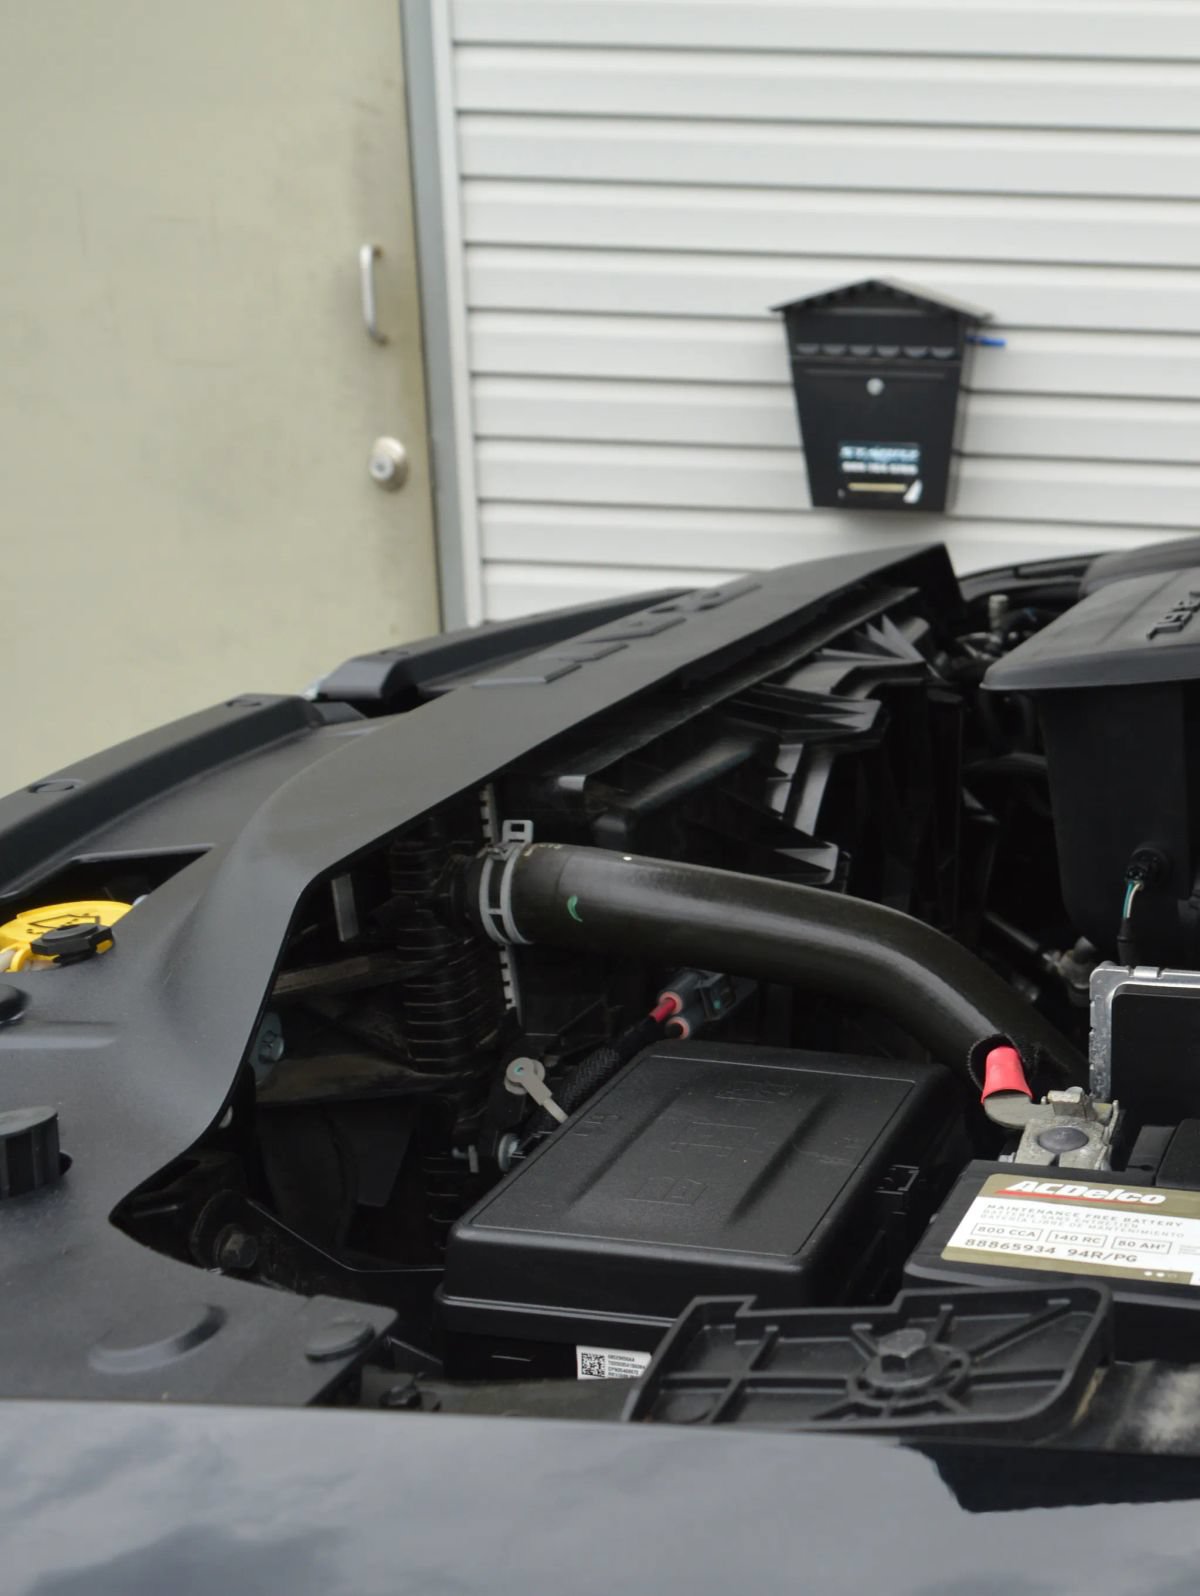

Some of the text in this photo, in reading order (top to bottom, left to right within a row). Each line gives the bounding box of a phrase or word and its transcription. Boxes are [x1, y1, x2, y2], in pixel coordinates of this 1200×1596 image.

[1004, 1180, 1166, 1205] ACDelco
[987, 1204, 1185, 1227] MAINTENANCE FREE BATTERY
[977, 1226, 1036, 1238] 800 CCA
[1054, 1233, 1102, 1244] 140 RC
[965, 1239, 1138, 1263] 88865934 94R/PG
